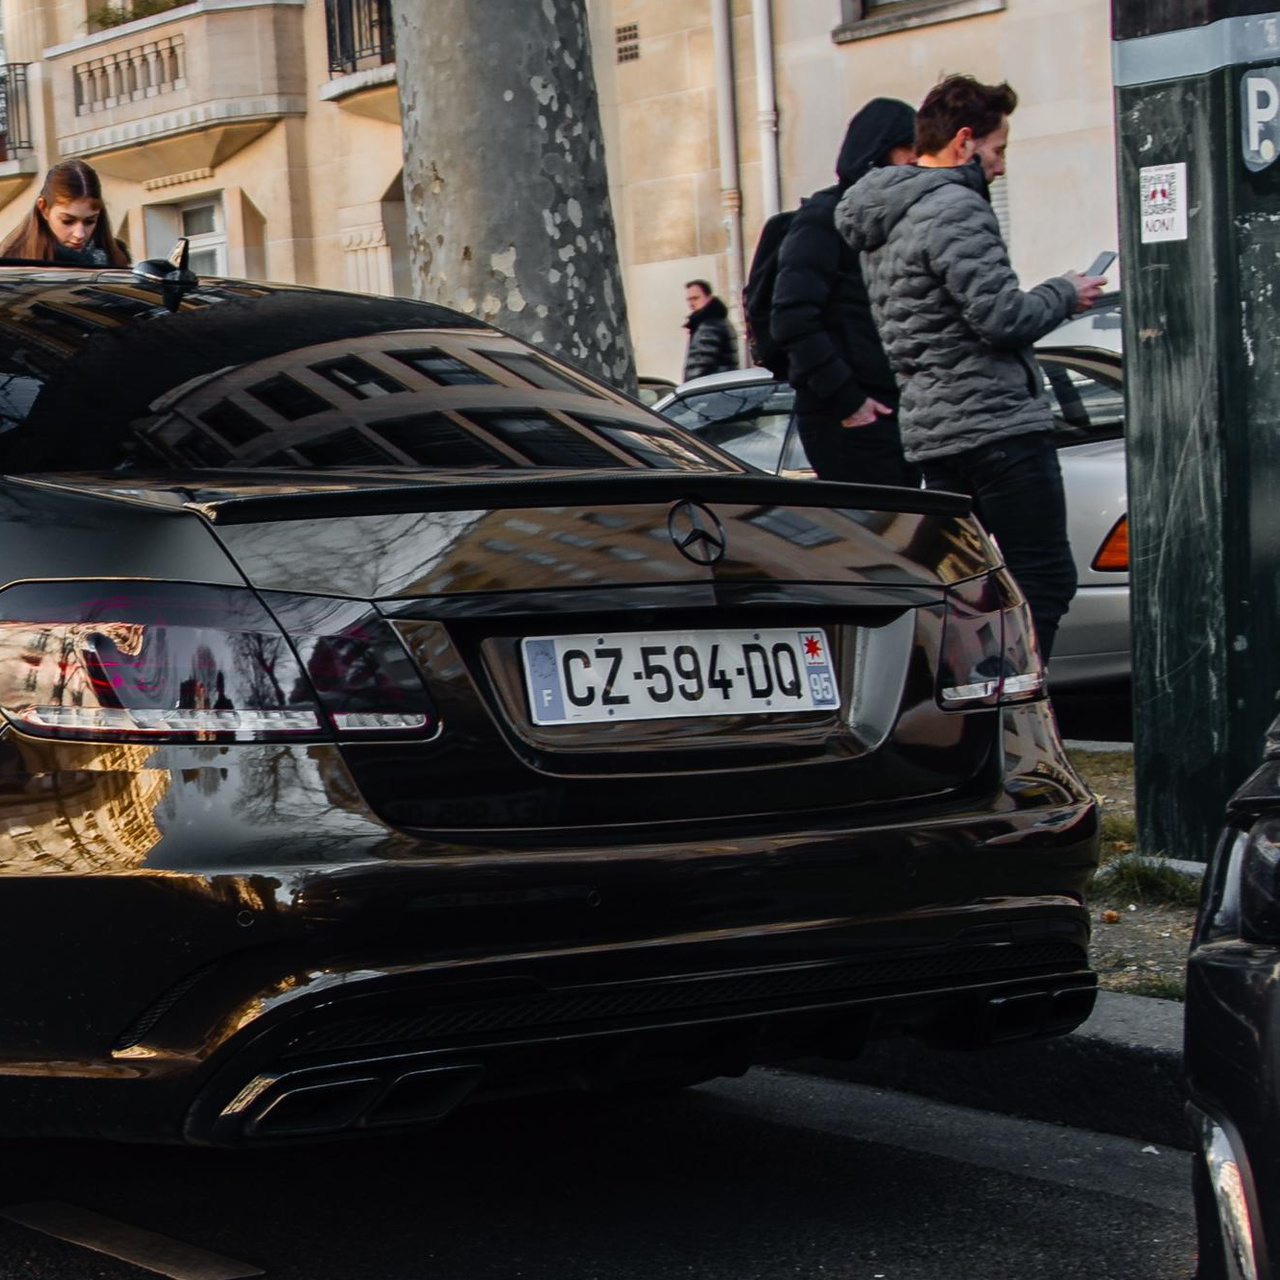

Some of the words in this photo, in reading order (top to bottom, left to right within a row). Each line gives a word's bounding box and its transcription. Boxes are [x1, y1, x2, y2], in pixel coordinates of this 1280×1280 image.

[1246, 77, 1279, 151] P
[542, 688, 554, 708] F
[562, 642, 803, 708] CZ-594-DQ
[809, 673, 834, 701] 95
